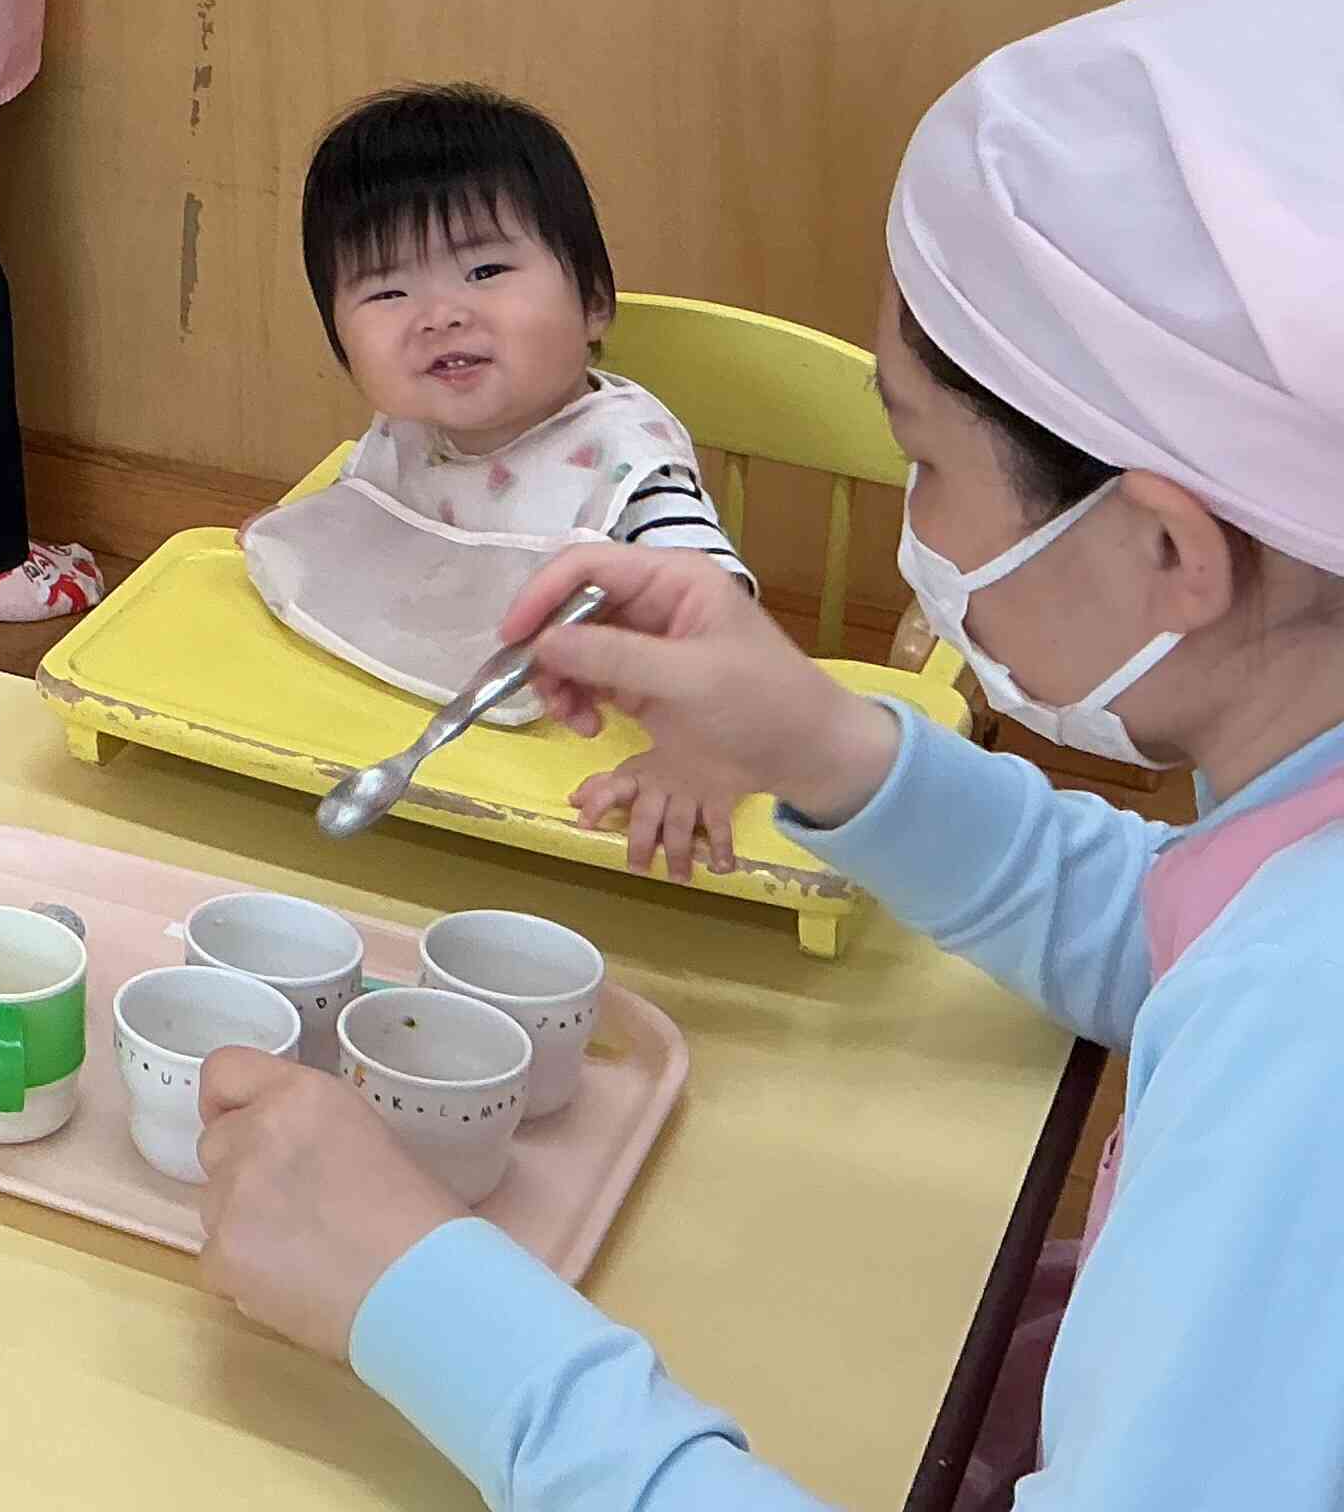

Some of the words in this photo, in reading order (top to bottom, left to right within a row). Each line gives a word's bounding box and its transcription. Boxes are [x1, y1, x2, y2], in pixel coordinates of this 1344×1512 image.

[161, 1071, 173, 1086] U
[392, 1095, 403, 1111] K
[480, 1104, 494, 1121] M
